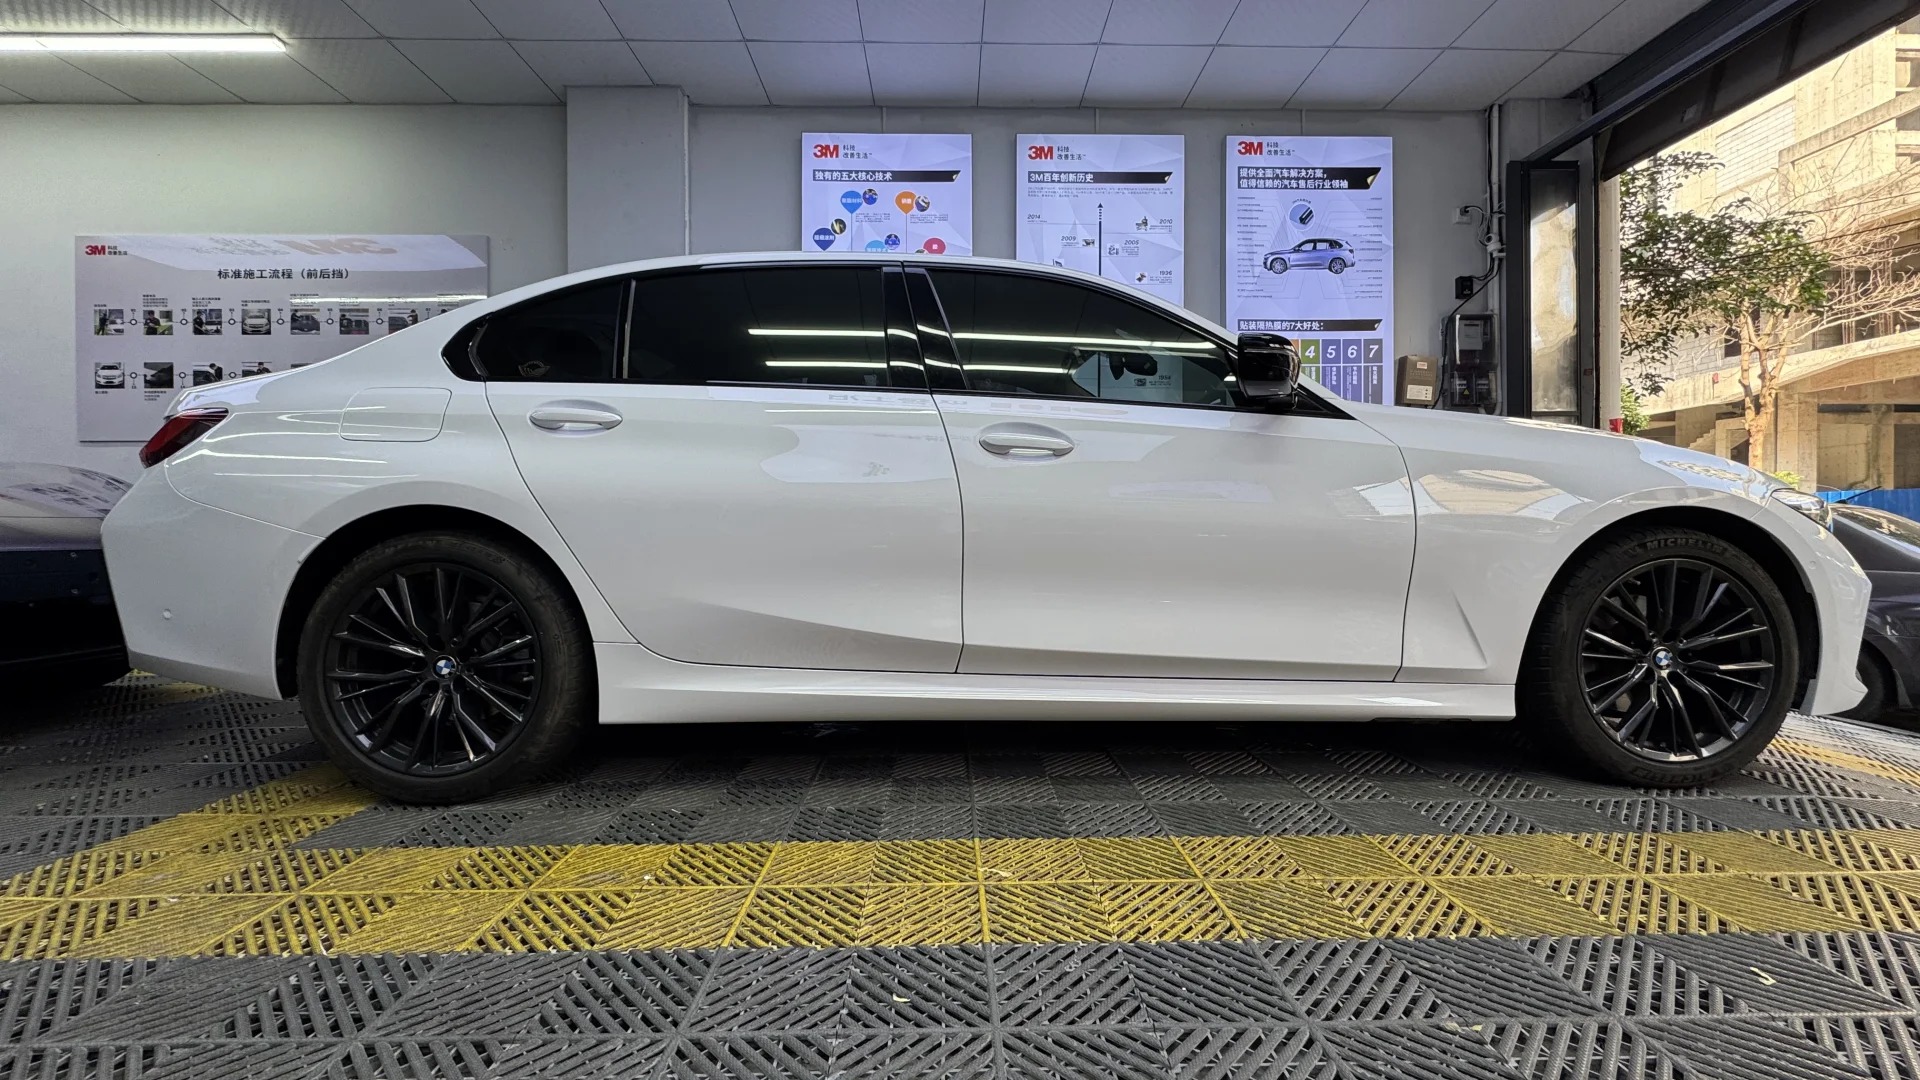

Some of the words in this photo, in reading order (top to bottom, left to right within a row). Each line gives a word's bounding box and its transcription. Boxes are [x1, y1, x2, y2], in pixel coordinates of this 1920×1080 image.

[813, 144, 839, 158] 3M
[1028, 145, 1053, 160] 3M
[1238, 141, 1263, 155] 3M
[815, 171, 892, 181] 独有的五大核心技术
[1030, 173, 1093, 182] 3M百年创新历史
[1240, 179, 1348, 188] 值得信赖的汽车售后行业领袖
[85, 245, 106, 256] 3M
[1305, 345, 1316, 359] 4
[1326, 345, 1337, 359] 5
[1347, 345, 1358, 359] 6
[1368, 345, 1379, 358] 7
[1646, 537, 1724, 555] MICHELIN
